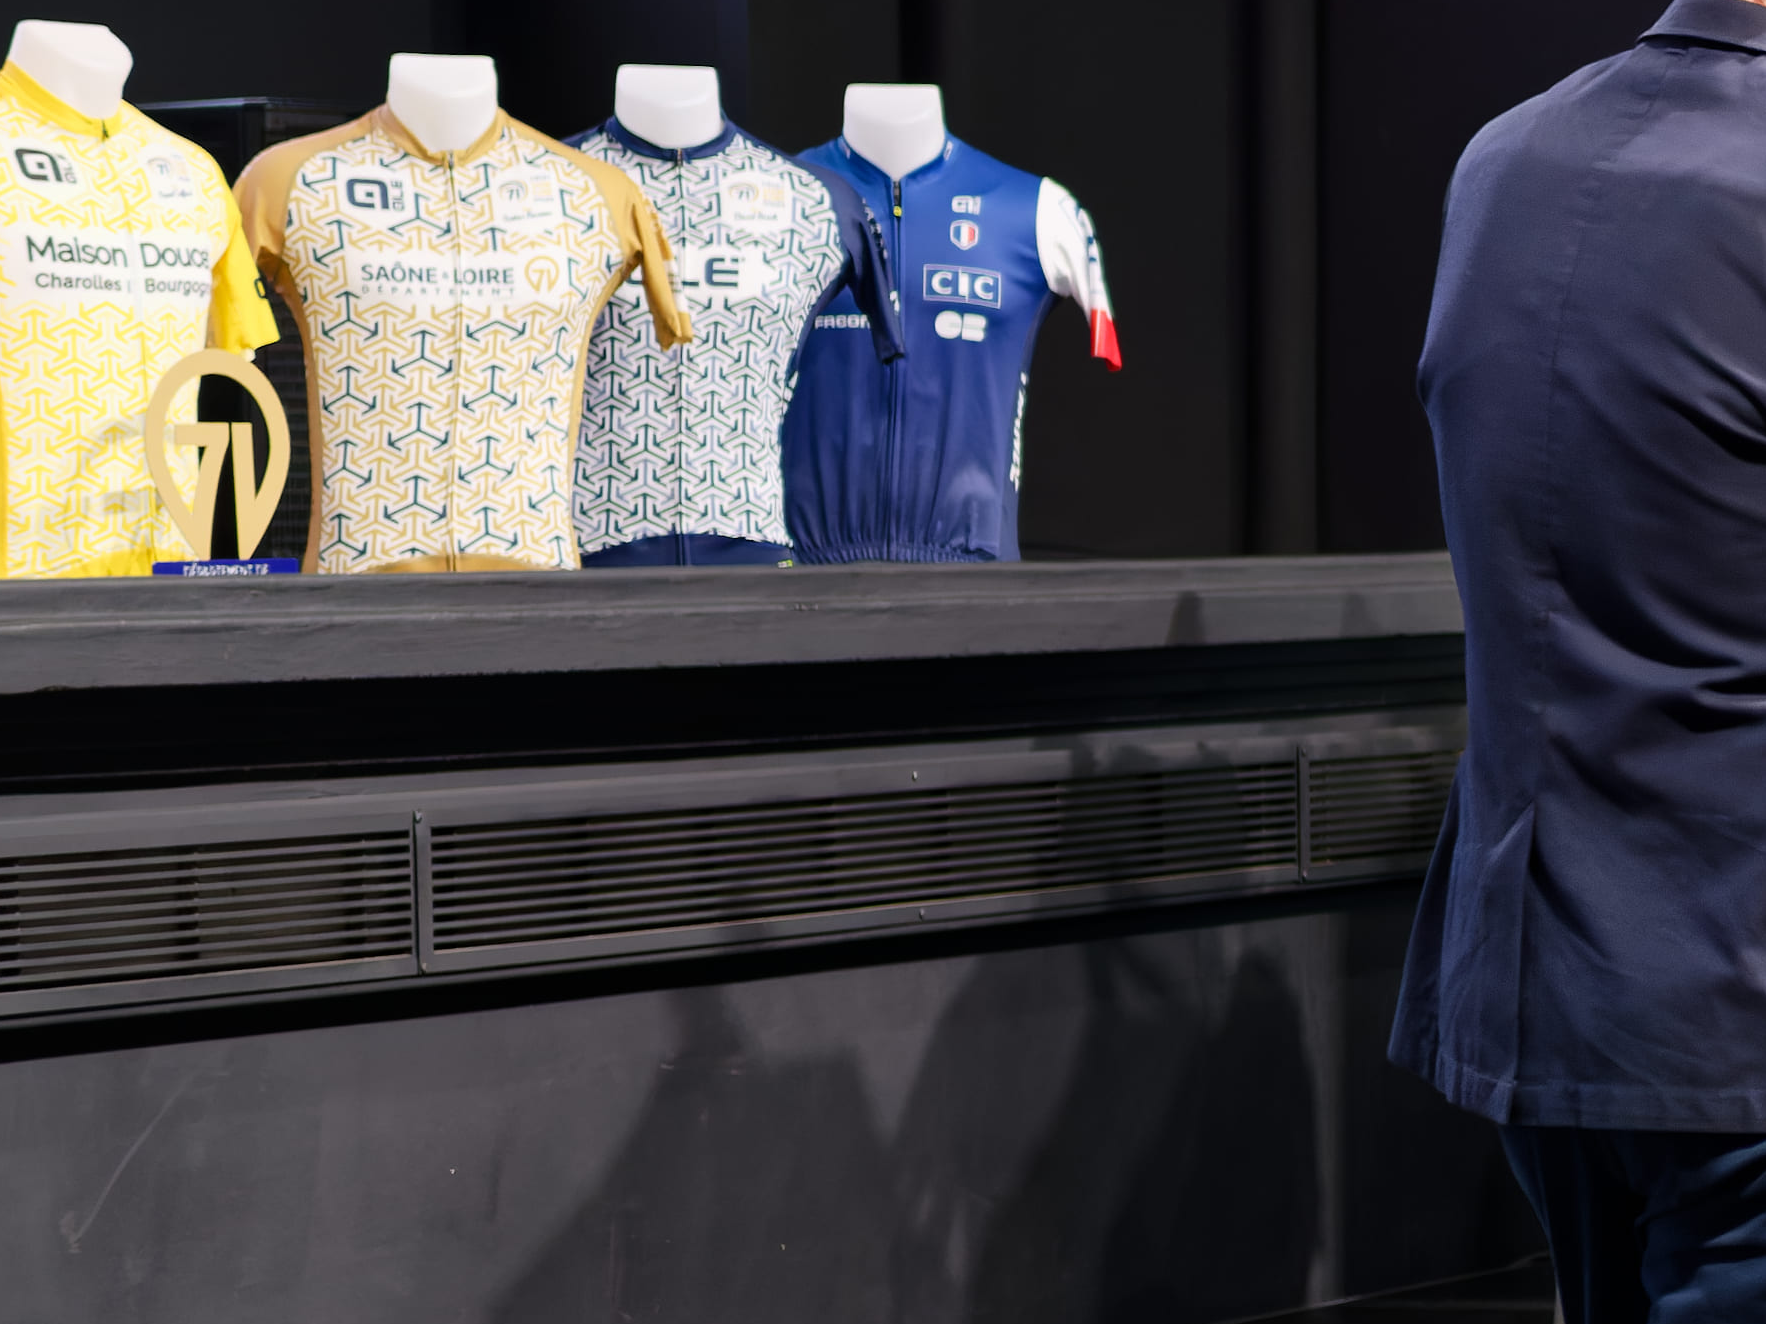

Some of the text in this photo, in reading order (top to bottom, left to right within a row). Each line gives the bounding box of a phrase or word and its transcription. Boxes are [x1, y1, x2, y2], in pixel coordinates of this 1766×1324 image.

[26, 235, 128, 268] Maison
[35, 272, 122, 291] Charolles
[361, 261, 438, 284] SAÔNE
[453, 267, 515, 285] LOIRE
[931, 270, 994, 301] CIC
